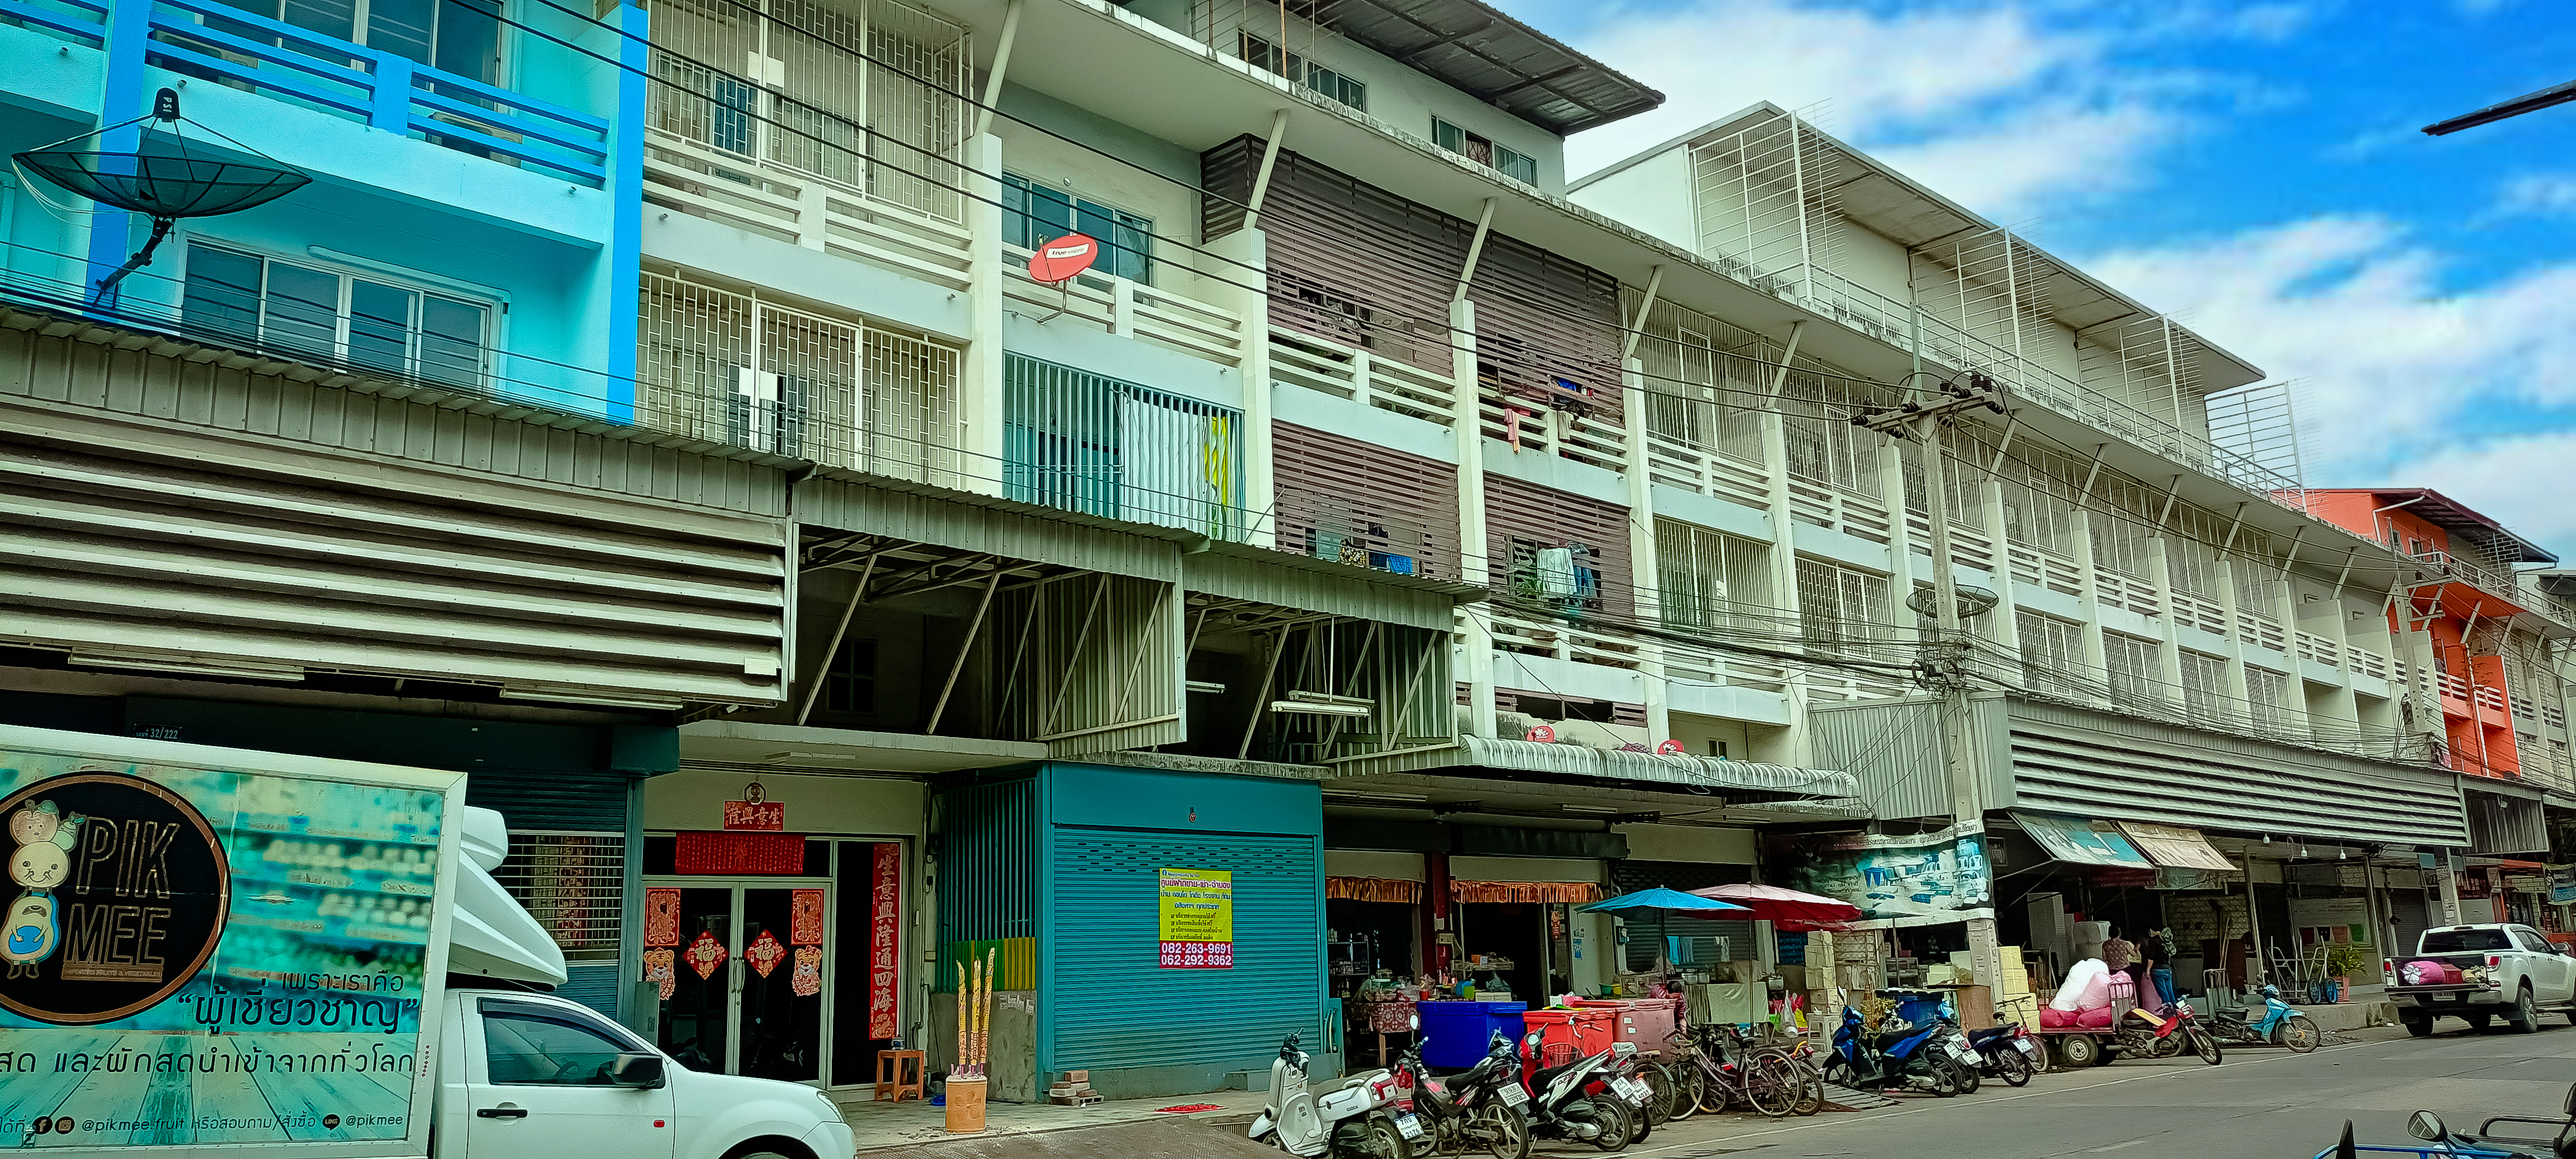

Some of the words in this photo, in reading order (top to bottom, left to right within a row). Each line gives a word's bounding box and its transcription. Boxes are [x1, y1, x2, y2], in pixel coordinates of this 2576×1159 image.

[150, 727, 178, 739] 32/222
[76, 816, 180, 899] PIK
[64, 903, 172, 966] MEE
[695, 938, 716, 961] 福
[755, 938, 774, 960] 福
[1162, 942, 1231, 954] 082-263-9691
[1161, 954, 1232, 966] 062-292-9362
[281, 969, 404, 992] เพราะเราคือ
[82, 1118, 186, 1133] @pikmee.fruit
[345, 1114, 403, 1129] @pikmee
[1405, 1128, 1420, 1138] 2176
